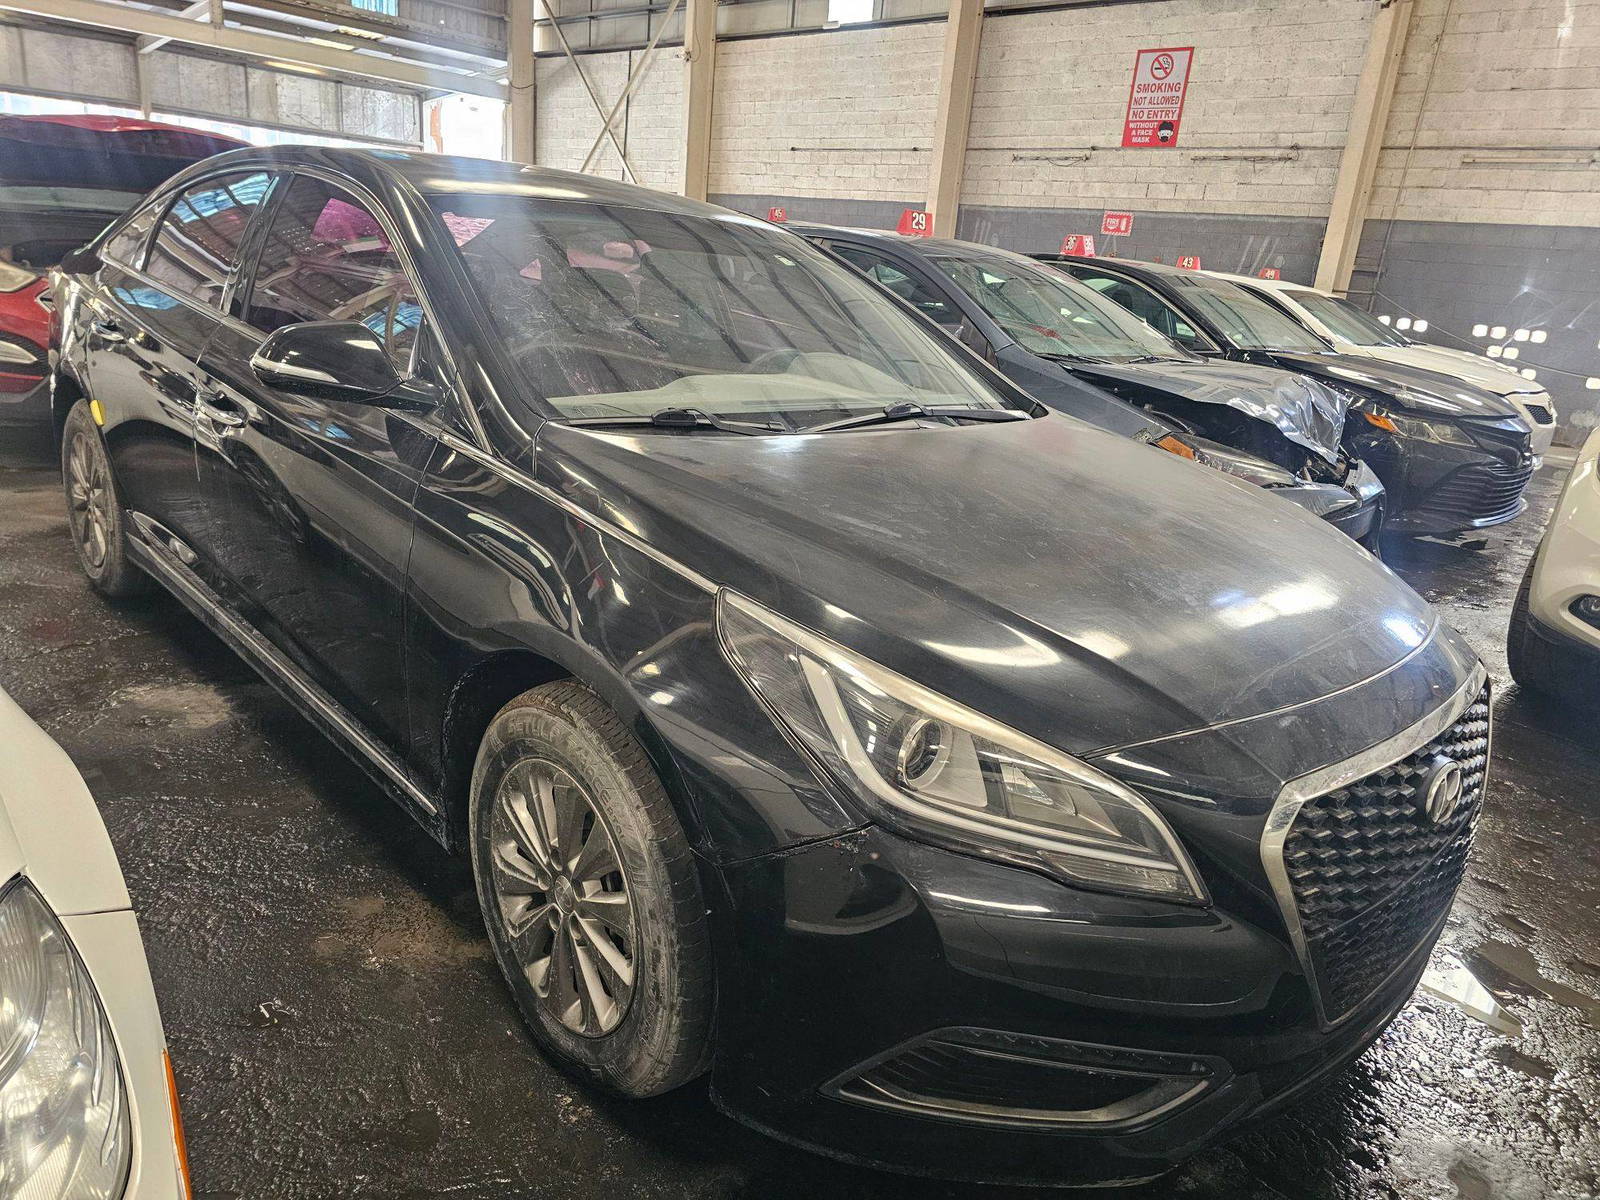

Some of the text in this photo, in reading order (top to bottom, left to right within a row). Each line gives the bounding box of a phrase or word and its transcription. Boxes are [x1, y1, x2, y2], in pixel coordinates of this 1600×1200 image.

[1136, 82, 1181, 93] SMOKING
[1133, 96, 1180, 106] NOT ALLOWED
[1131, 110, 1177, 119] NO ENTRY
[912, 212, 926, 230] 29
[1182, 256, 1194, 268] 43
